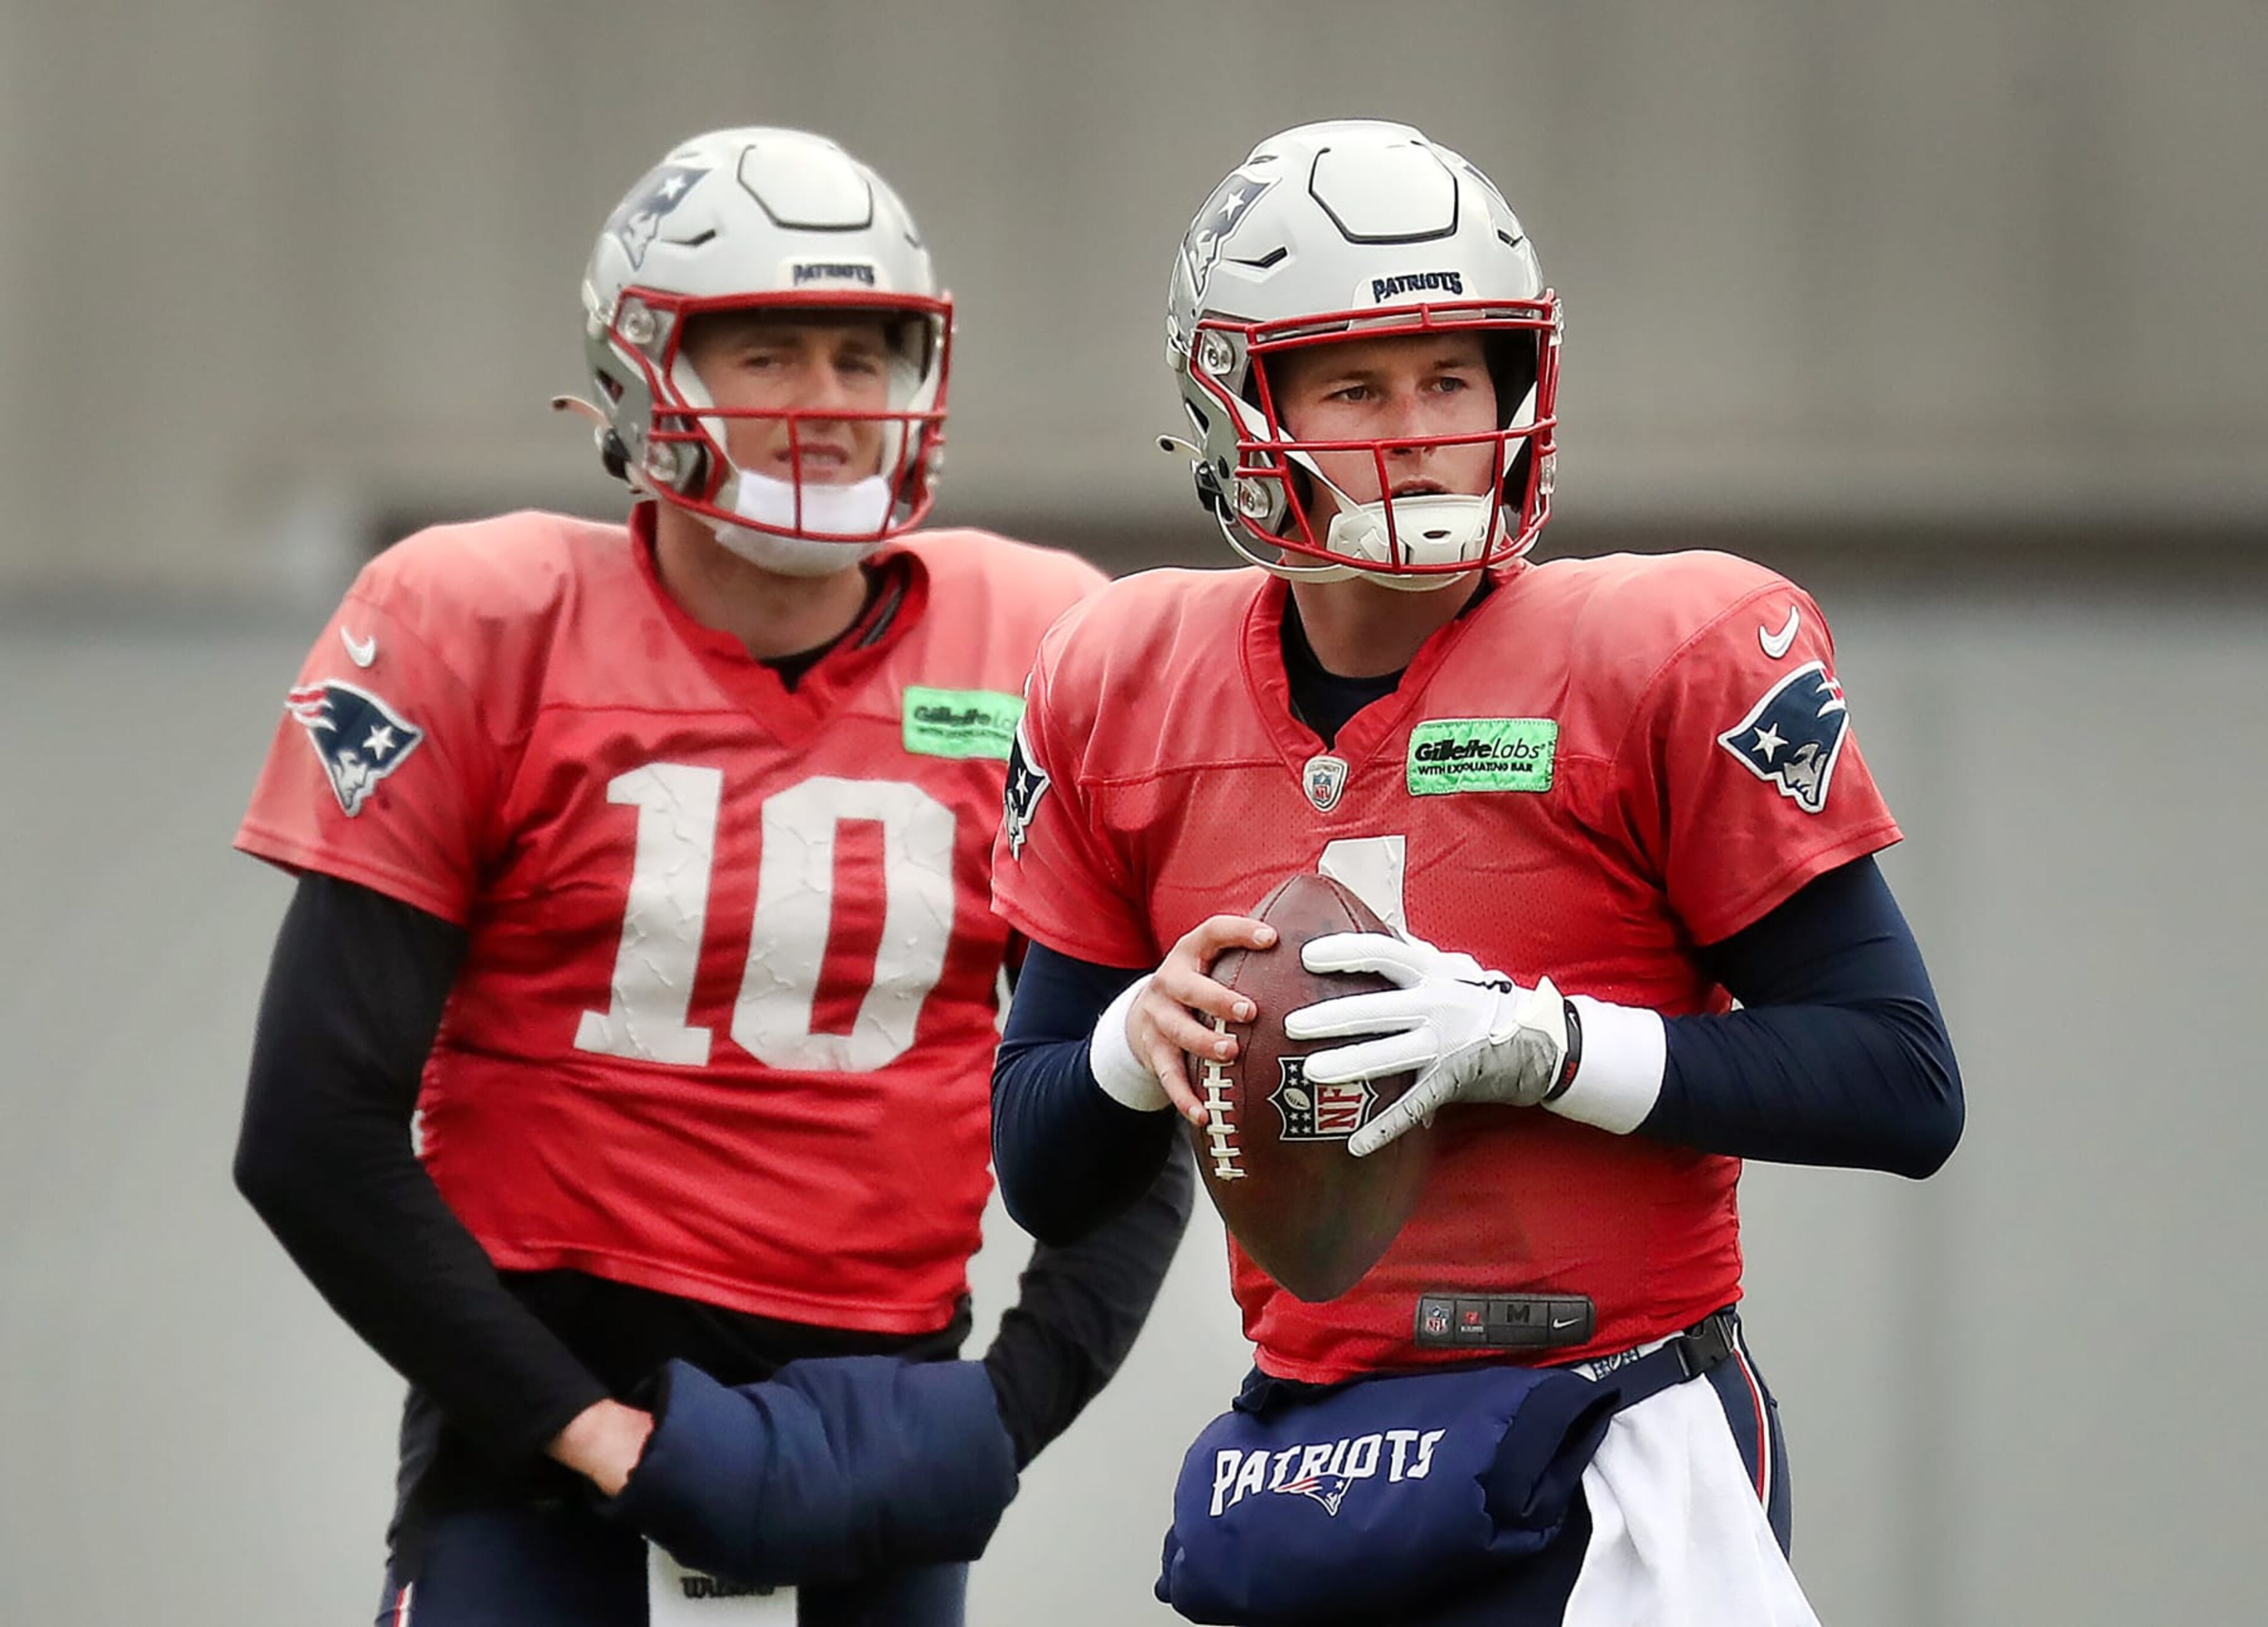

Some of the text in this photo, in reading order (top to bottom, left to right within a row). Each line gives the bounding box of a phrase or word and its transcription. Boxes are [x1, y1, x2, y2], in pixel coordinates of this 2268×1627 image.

[794, 263, 875, 287] PATRIOTS
[1371, 272, 1463, 304] PATRIOTS
[1419, 766, 1445, 775] WITH
[1510, 762, 1533, 772] BAR
[573, 762, 956, 1072] 10
[1318, 1086, 1363, 1131] NF
[1507, 1304, 1530, 1323] M
[1209, 1428, 1446, 1517] PATRIOTS
